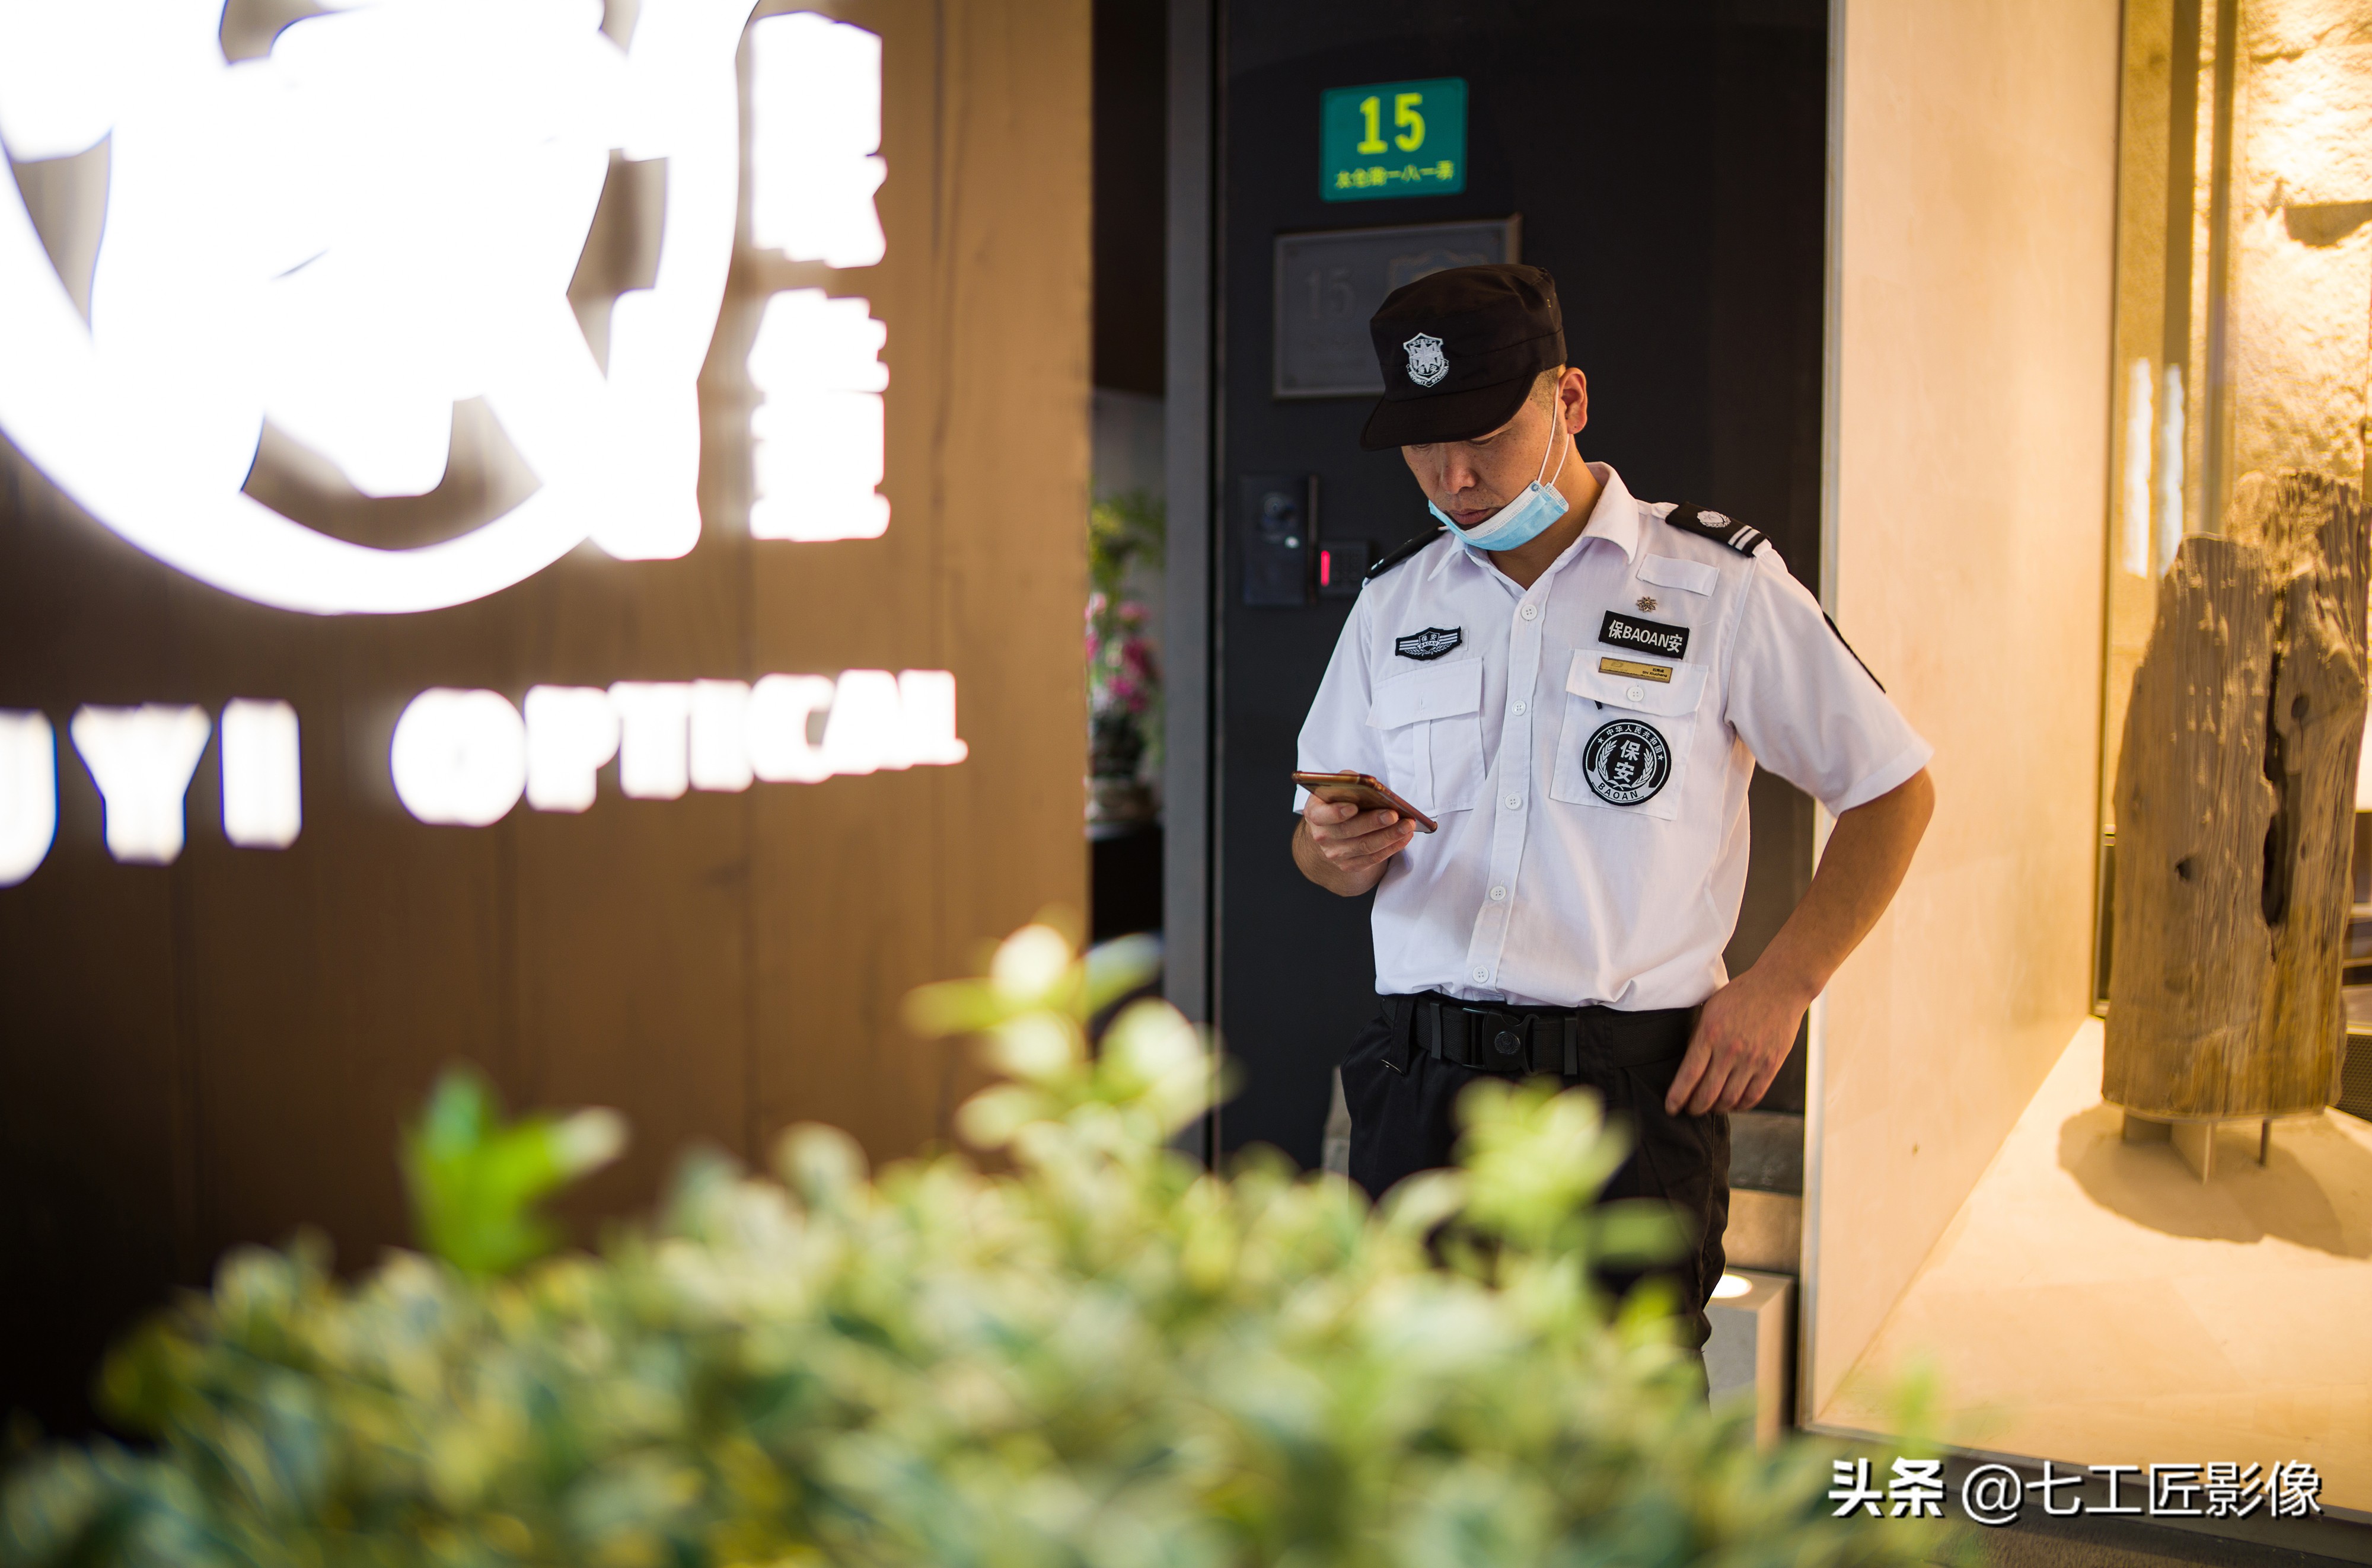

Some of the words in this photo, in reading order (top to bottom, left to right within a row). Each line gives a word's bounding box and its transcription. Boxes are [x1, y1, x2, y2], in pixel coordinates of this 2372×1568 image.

[1357, 92, 1426, 155] 15
[1608, 619, 1683, 653] 保BAOAN安
[390, 669, 969, 828] OPTICAL
[1606, 724, 1663, 754] 中华人民共和国
[1613, 739, 1641, 783] 保安
[1598, 782, 1638, 800] BAOAN
